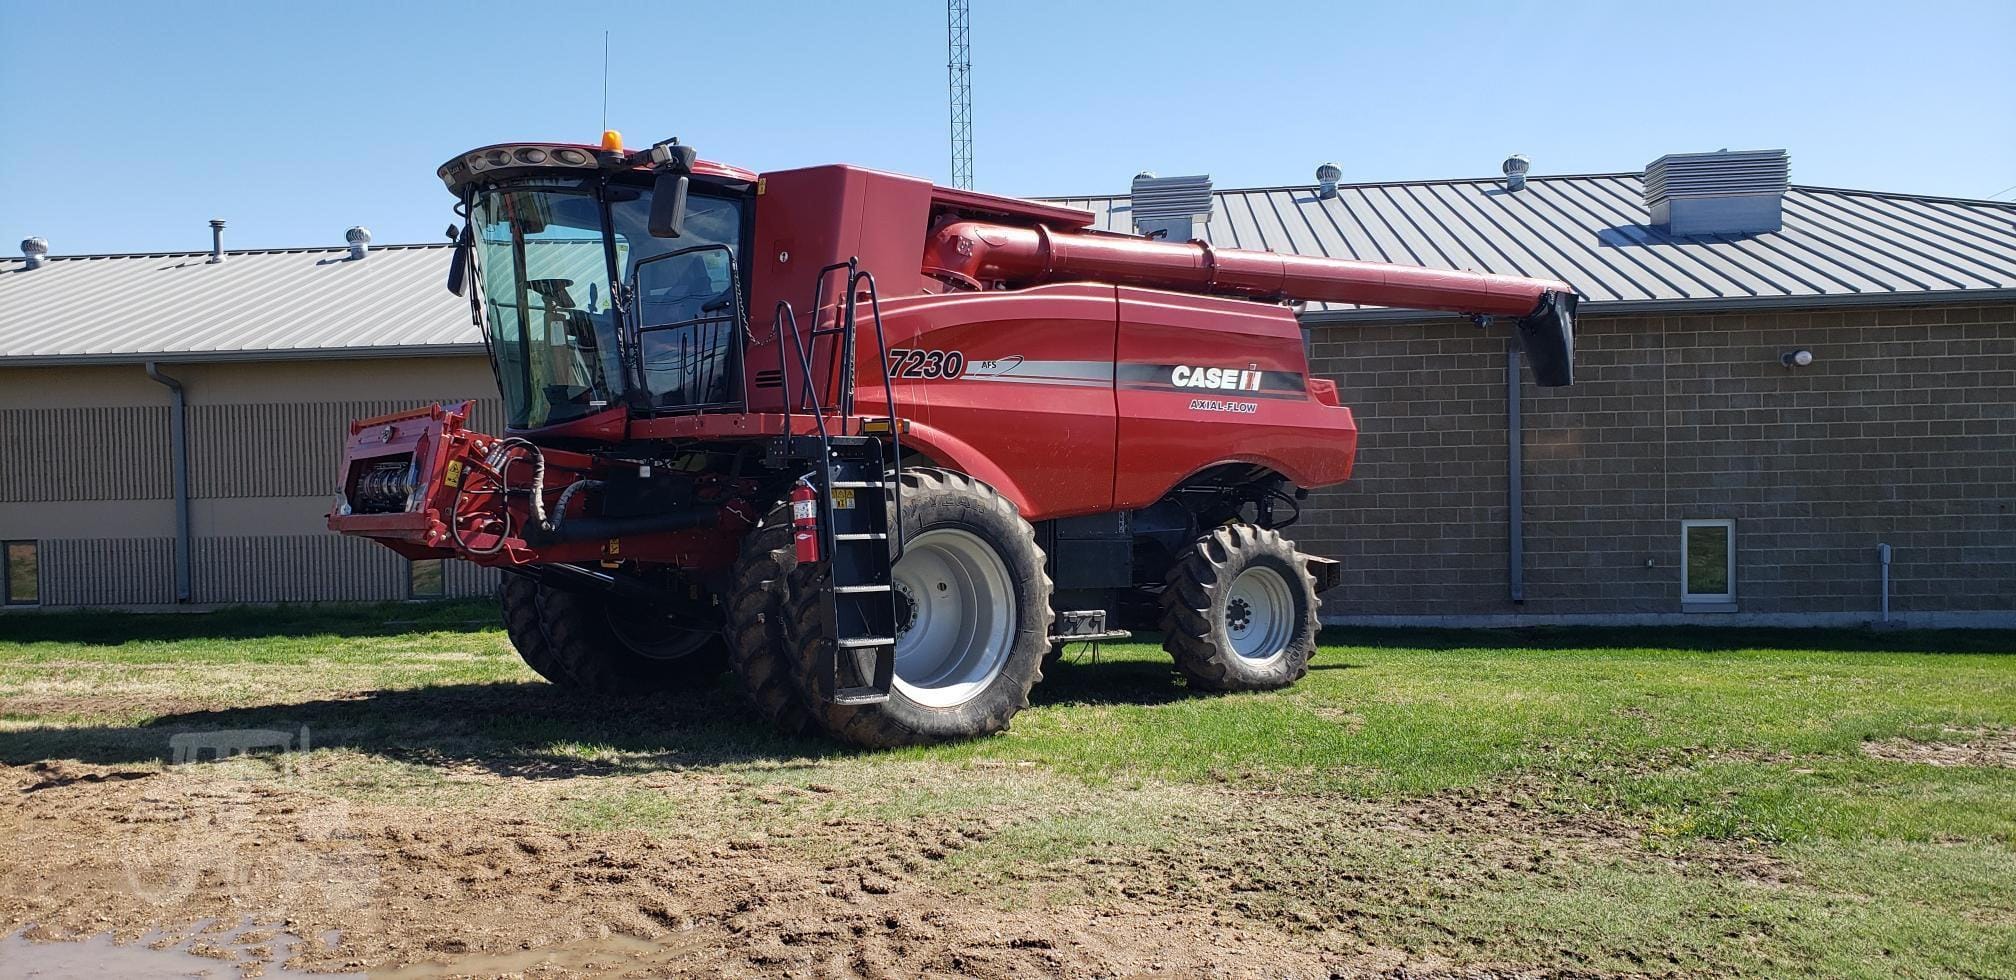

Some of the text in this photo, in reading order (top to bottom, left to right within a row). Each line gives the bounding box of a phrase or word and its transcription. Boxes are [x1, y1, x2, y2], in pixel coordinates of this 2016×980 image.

[889, 349, 964, 380] 7230
[981, 361, 997, 369] AFS
[1171, 365, 1239, 390] CASE
[1189, 400, 1257, 413] AXIAL-FLOW
